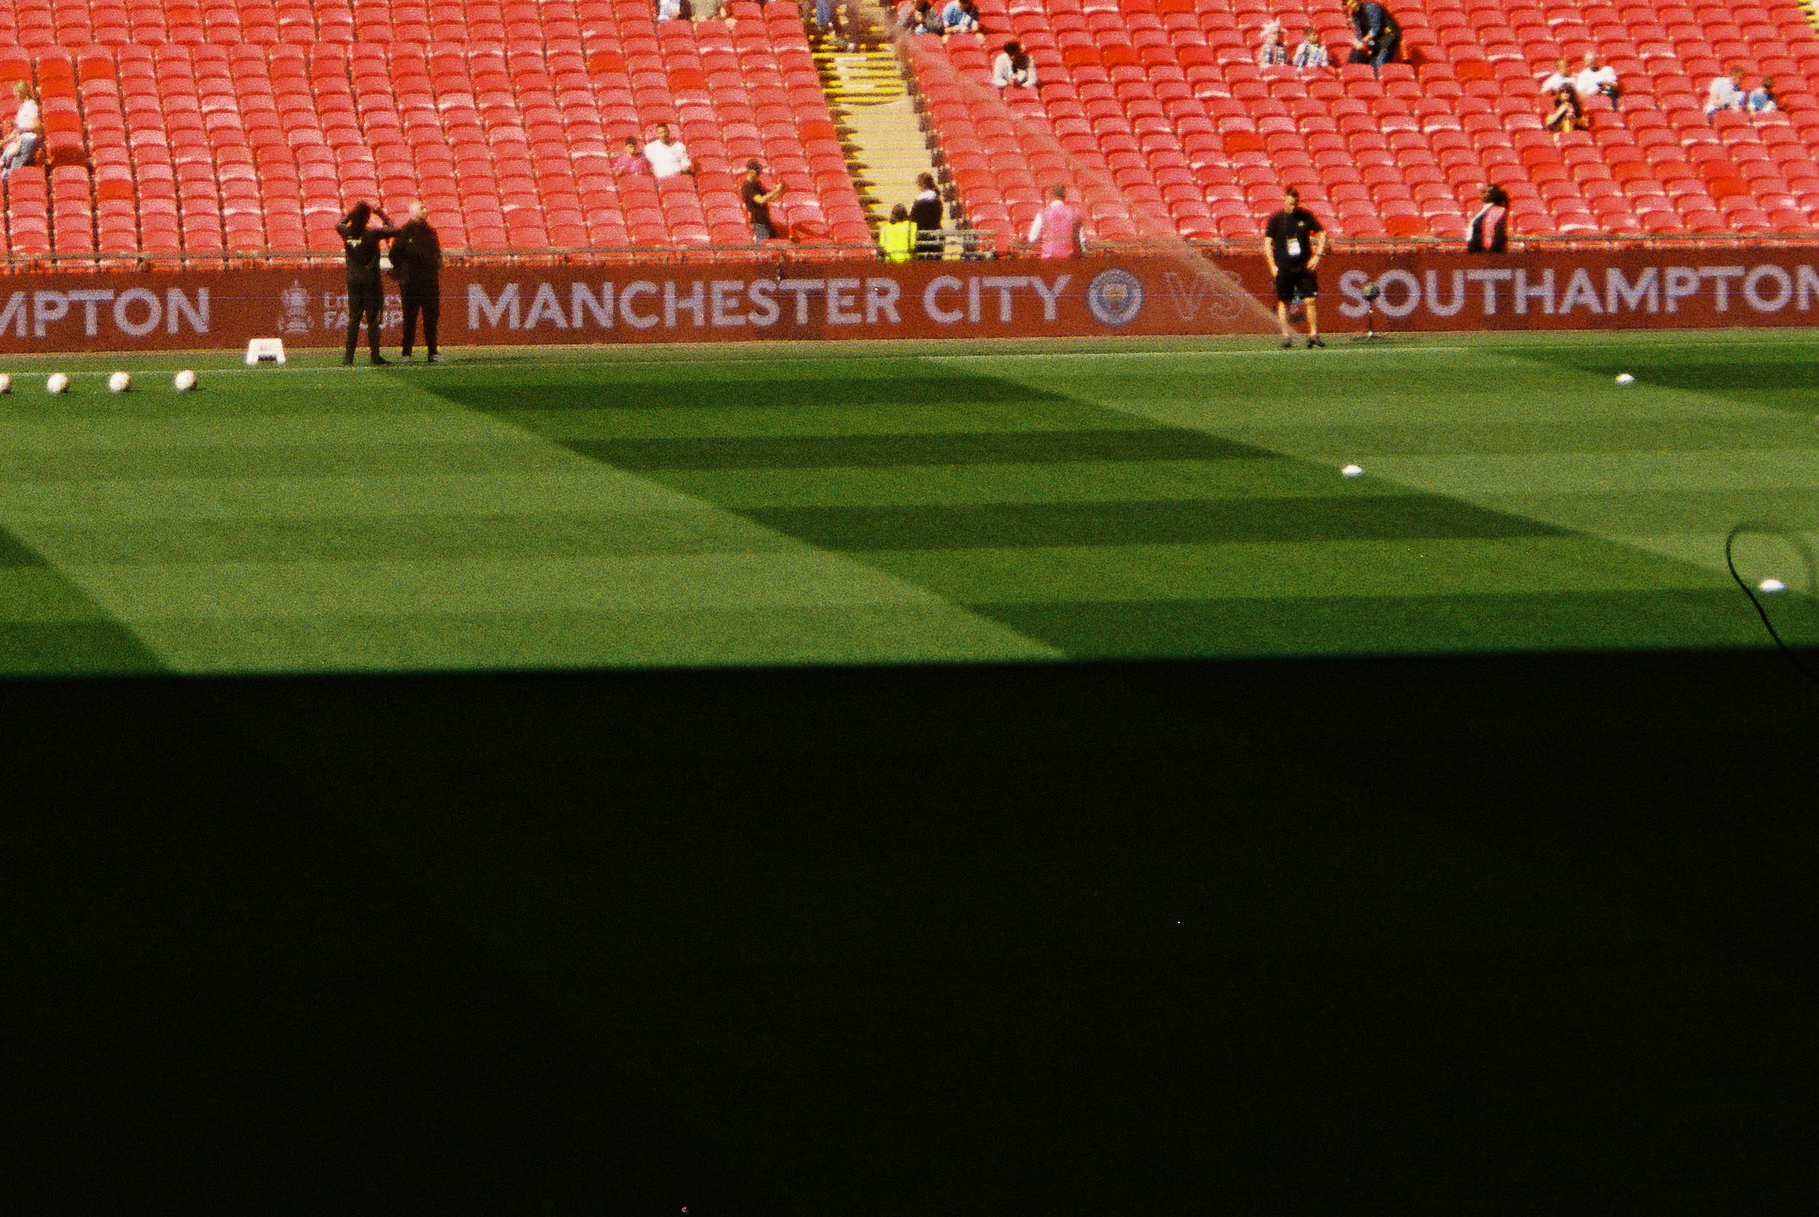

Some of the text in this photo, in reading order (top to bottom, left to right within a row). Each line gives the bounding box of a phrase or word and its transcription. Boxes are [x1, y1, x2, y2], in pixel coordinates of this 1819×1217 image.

[468, 277, 901, 330] MANCHESTER
[923, 274, 1072, 324] CITY
[1163, 270, 1245, 321] VS
